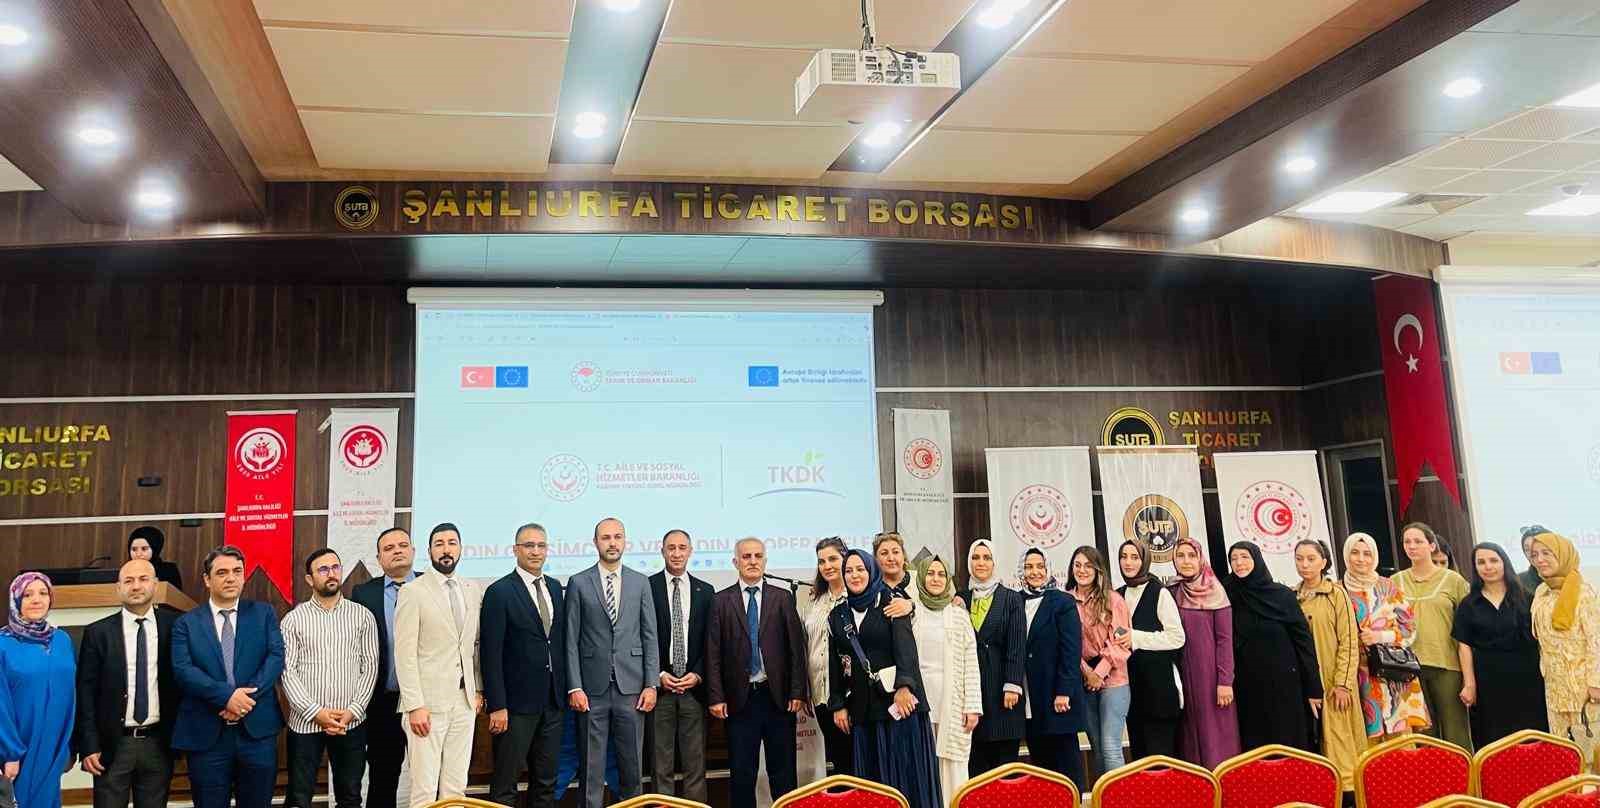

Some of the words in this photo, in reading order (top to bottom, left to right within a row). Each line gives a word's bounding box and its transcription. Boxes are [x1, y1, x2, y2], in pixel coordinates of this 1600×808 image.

[402, 189, 658, 223] ŞANLIURFA
[674, 186, 850, 222] TİCARET
[868, 199, 1034, 229] BORSASI
[1168, 410, 1272, 429] ŞANLIURFA
[1182, 430, 1261, 447] TİCARET
[767, 465, 825, 484] TKDK
